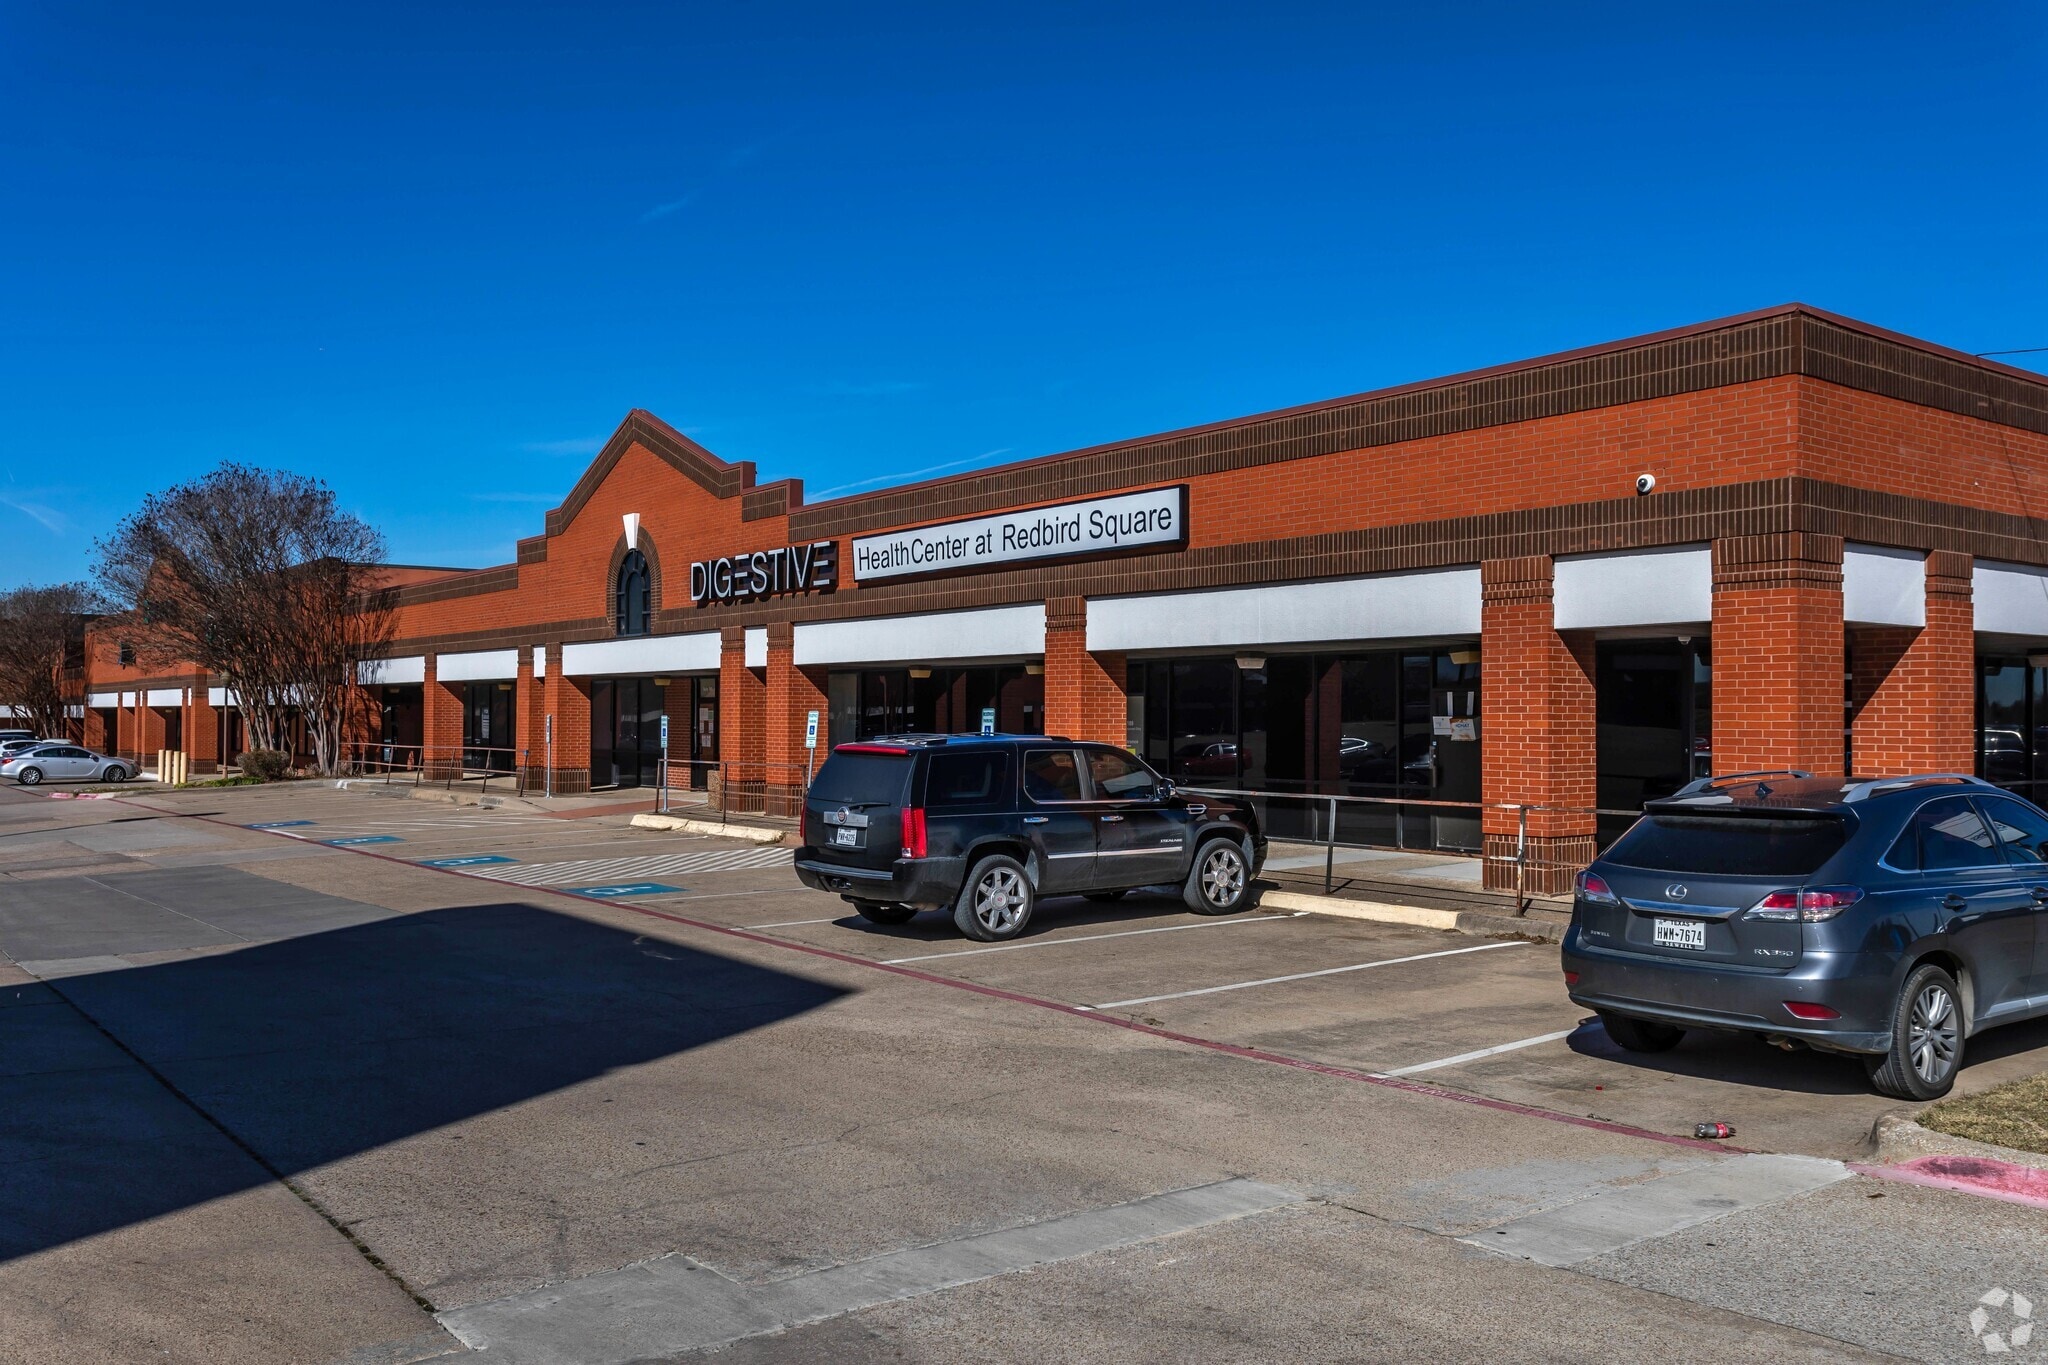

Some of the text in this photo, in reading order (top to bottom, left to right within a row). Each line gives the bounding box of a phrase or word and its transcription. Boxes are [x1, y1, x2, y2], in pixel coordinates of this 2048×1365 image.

[975, 528, 993, 555] at
[1002, 513, 1080, 551] Redbird
[1089, 507, 1172, 544] Square
[691, 540, 831, 601] DIGESTIVE
